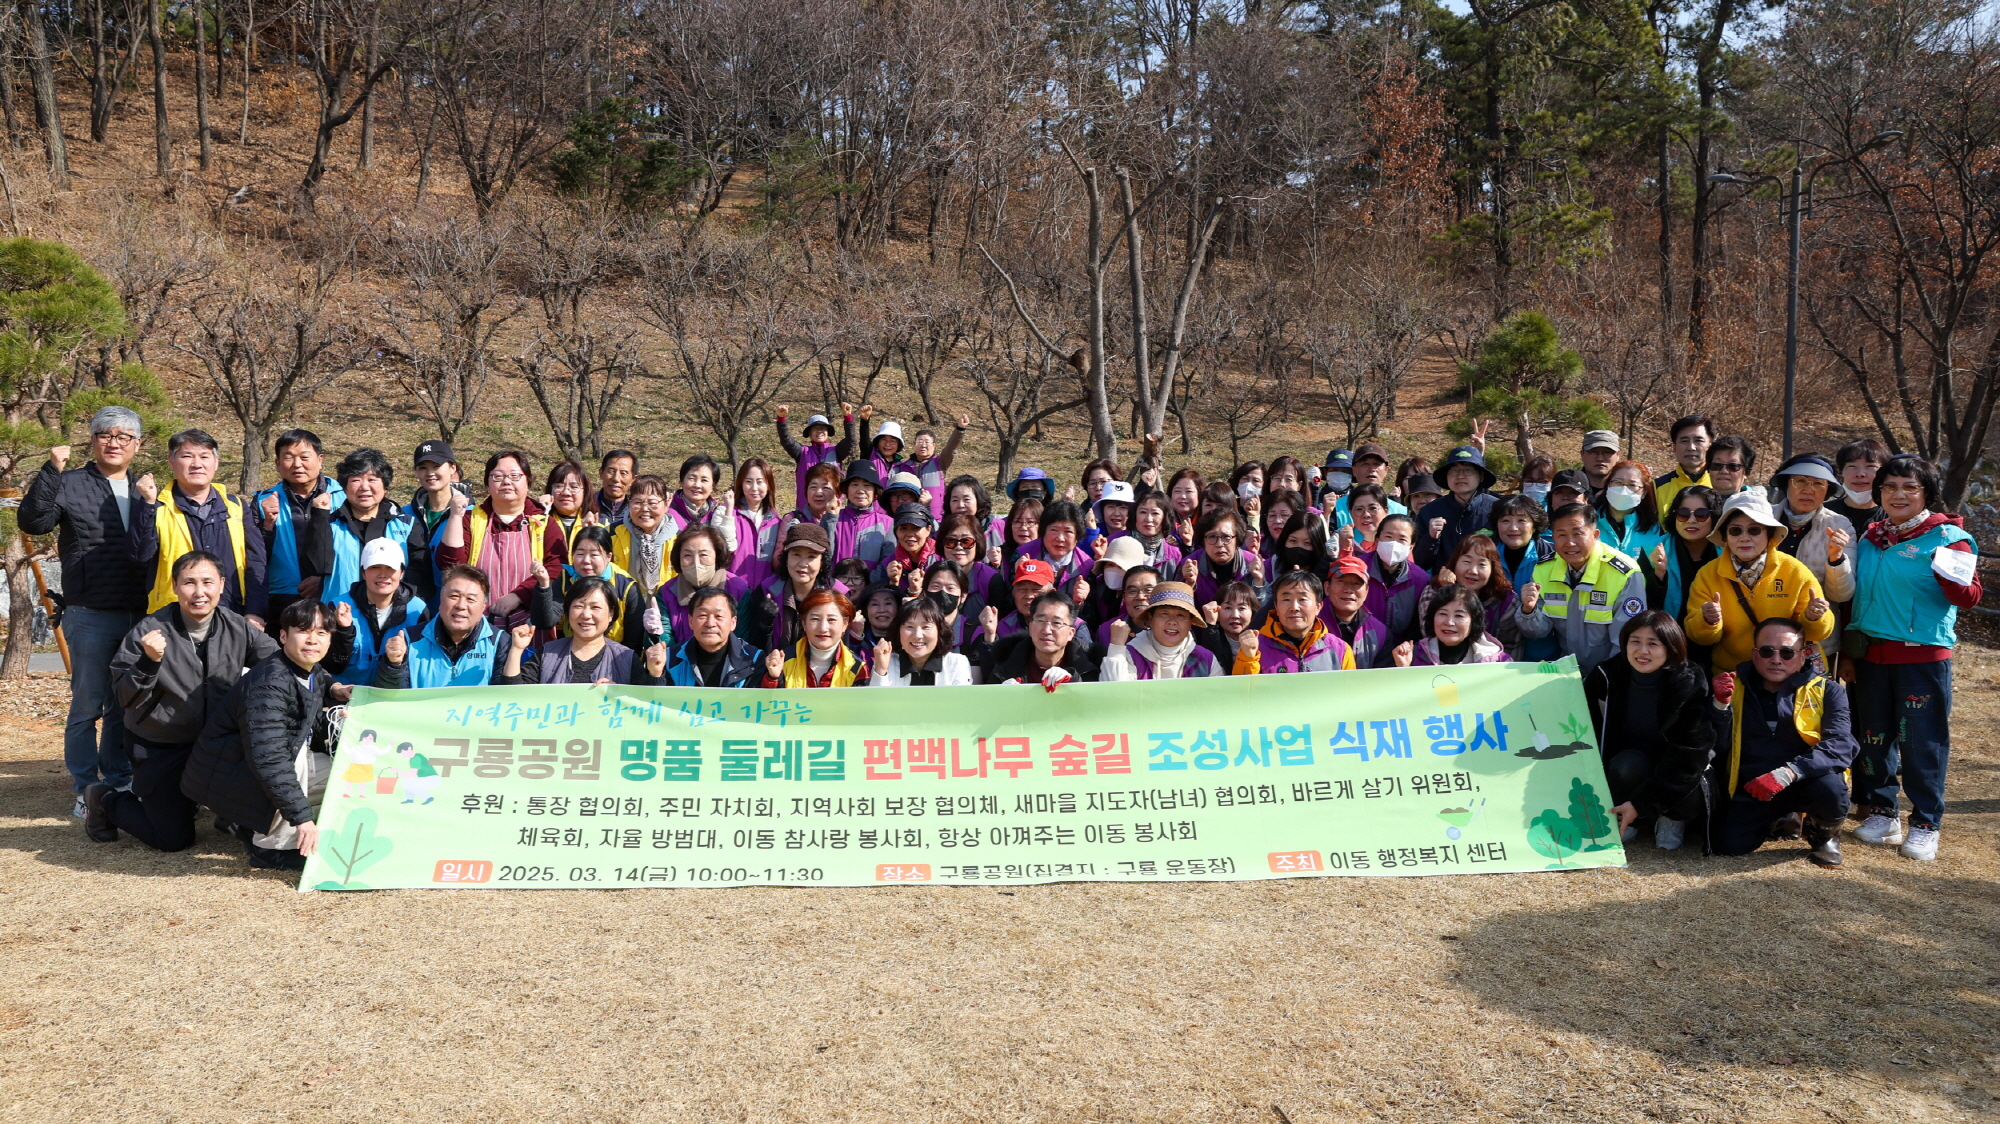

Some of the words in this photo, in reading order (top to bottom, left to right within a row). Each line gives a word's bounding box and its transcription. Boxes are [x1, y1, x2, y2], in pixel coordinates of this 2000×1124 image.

[446, 702, 585, 731] 지역주민과
[599, 696, 661, 728] 함께
[678, 700, 727, 727] 심고
[741, 699, 812, 728] 가꾸는
[429, 737, 601, 779] 구룡공원
[620, 740, 702, 781] 명품
[720, 740, 845, 781] 둘레길
[863, 735, 1036, 780] 편백나무
[1048, 732, 1131, 776] 숲길
[1148, 724, 1314, 770] 조성사업
[1330, 718, 1412, 761] 식재
[1423, 711, 1508, 755] 행사
[461, 794, 503, 814] 후원
[527, 797, 570, 816] 통장
[580, 797, 648, 817] 협의회,
[660, 798, 700, 817] 주민
[711, 798, 780, 818] 자치회,
[791, 797, 874, 817] 지역사회
[886, 797, 927, 816] 보장
[935, 795, 1005, 815] 협의체,
[1015, 793, 1076, 813] 새마을
[1086, 788, 1206, 811] 지도자(남녀)
[1215, 785, 1284, 806] 협의회,
[1292, 780, 1354, 801] 바르게
[1362, 777, 1402, 798] 살기
[1411, 772, 1479, 794] 위원회,
[517, 827, 588, 848] 체육회,
[599, 829, 642, 848] 자율
[652, 830, 722, 849] 방범대,
[734, 830, 775, 849] 이동
[785, 829, 850, 849] 참사랑
[859, 829, 929, 849] 봉사회,
[939, 828, 981, 847] 항상
[990, 826, 1075, 846] 아껴주는
[1085, 824, 1125, 843] 이동
[1135, 821, 1197, 842] 봉사회
[882, 865, 926, 881] 장소
[1118, 861, 1157, 875] 구룡
[1167, 857, 1235, 875] 운동장)
[1275, 853, 1317, 872] 주최
[1330, 851, 1370, 868] 이동
[1377, 845, 1459, 867] 행정복지
[1467, 842, 1506, 862] 센터
[442, 863, 484, 882] 일시
[499, 866, 559, 881] 2025.
[570, 867, 601, 881] 03.
[615, 866, 676, 881] 14(금)
[688, 868, 823, 881] 10:00~11:30
